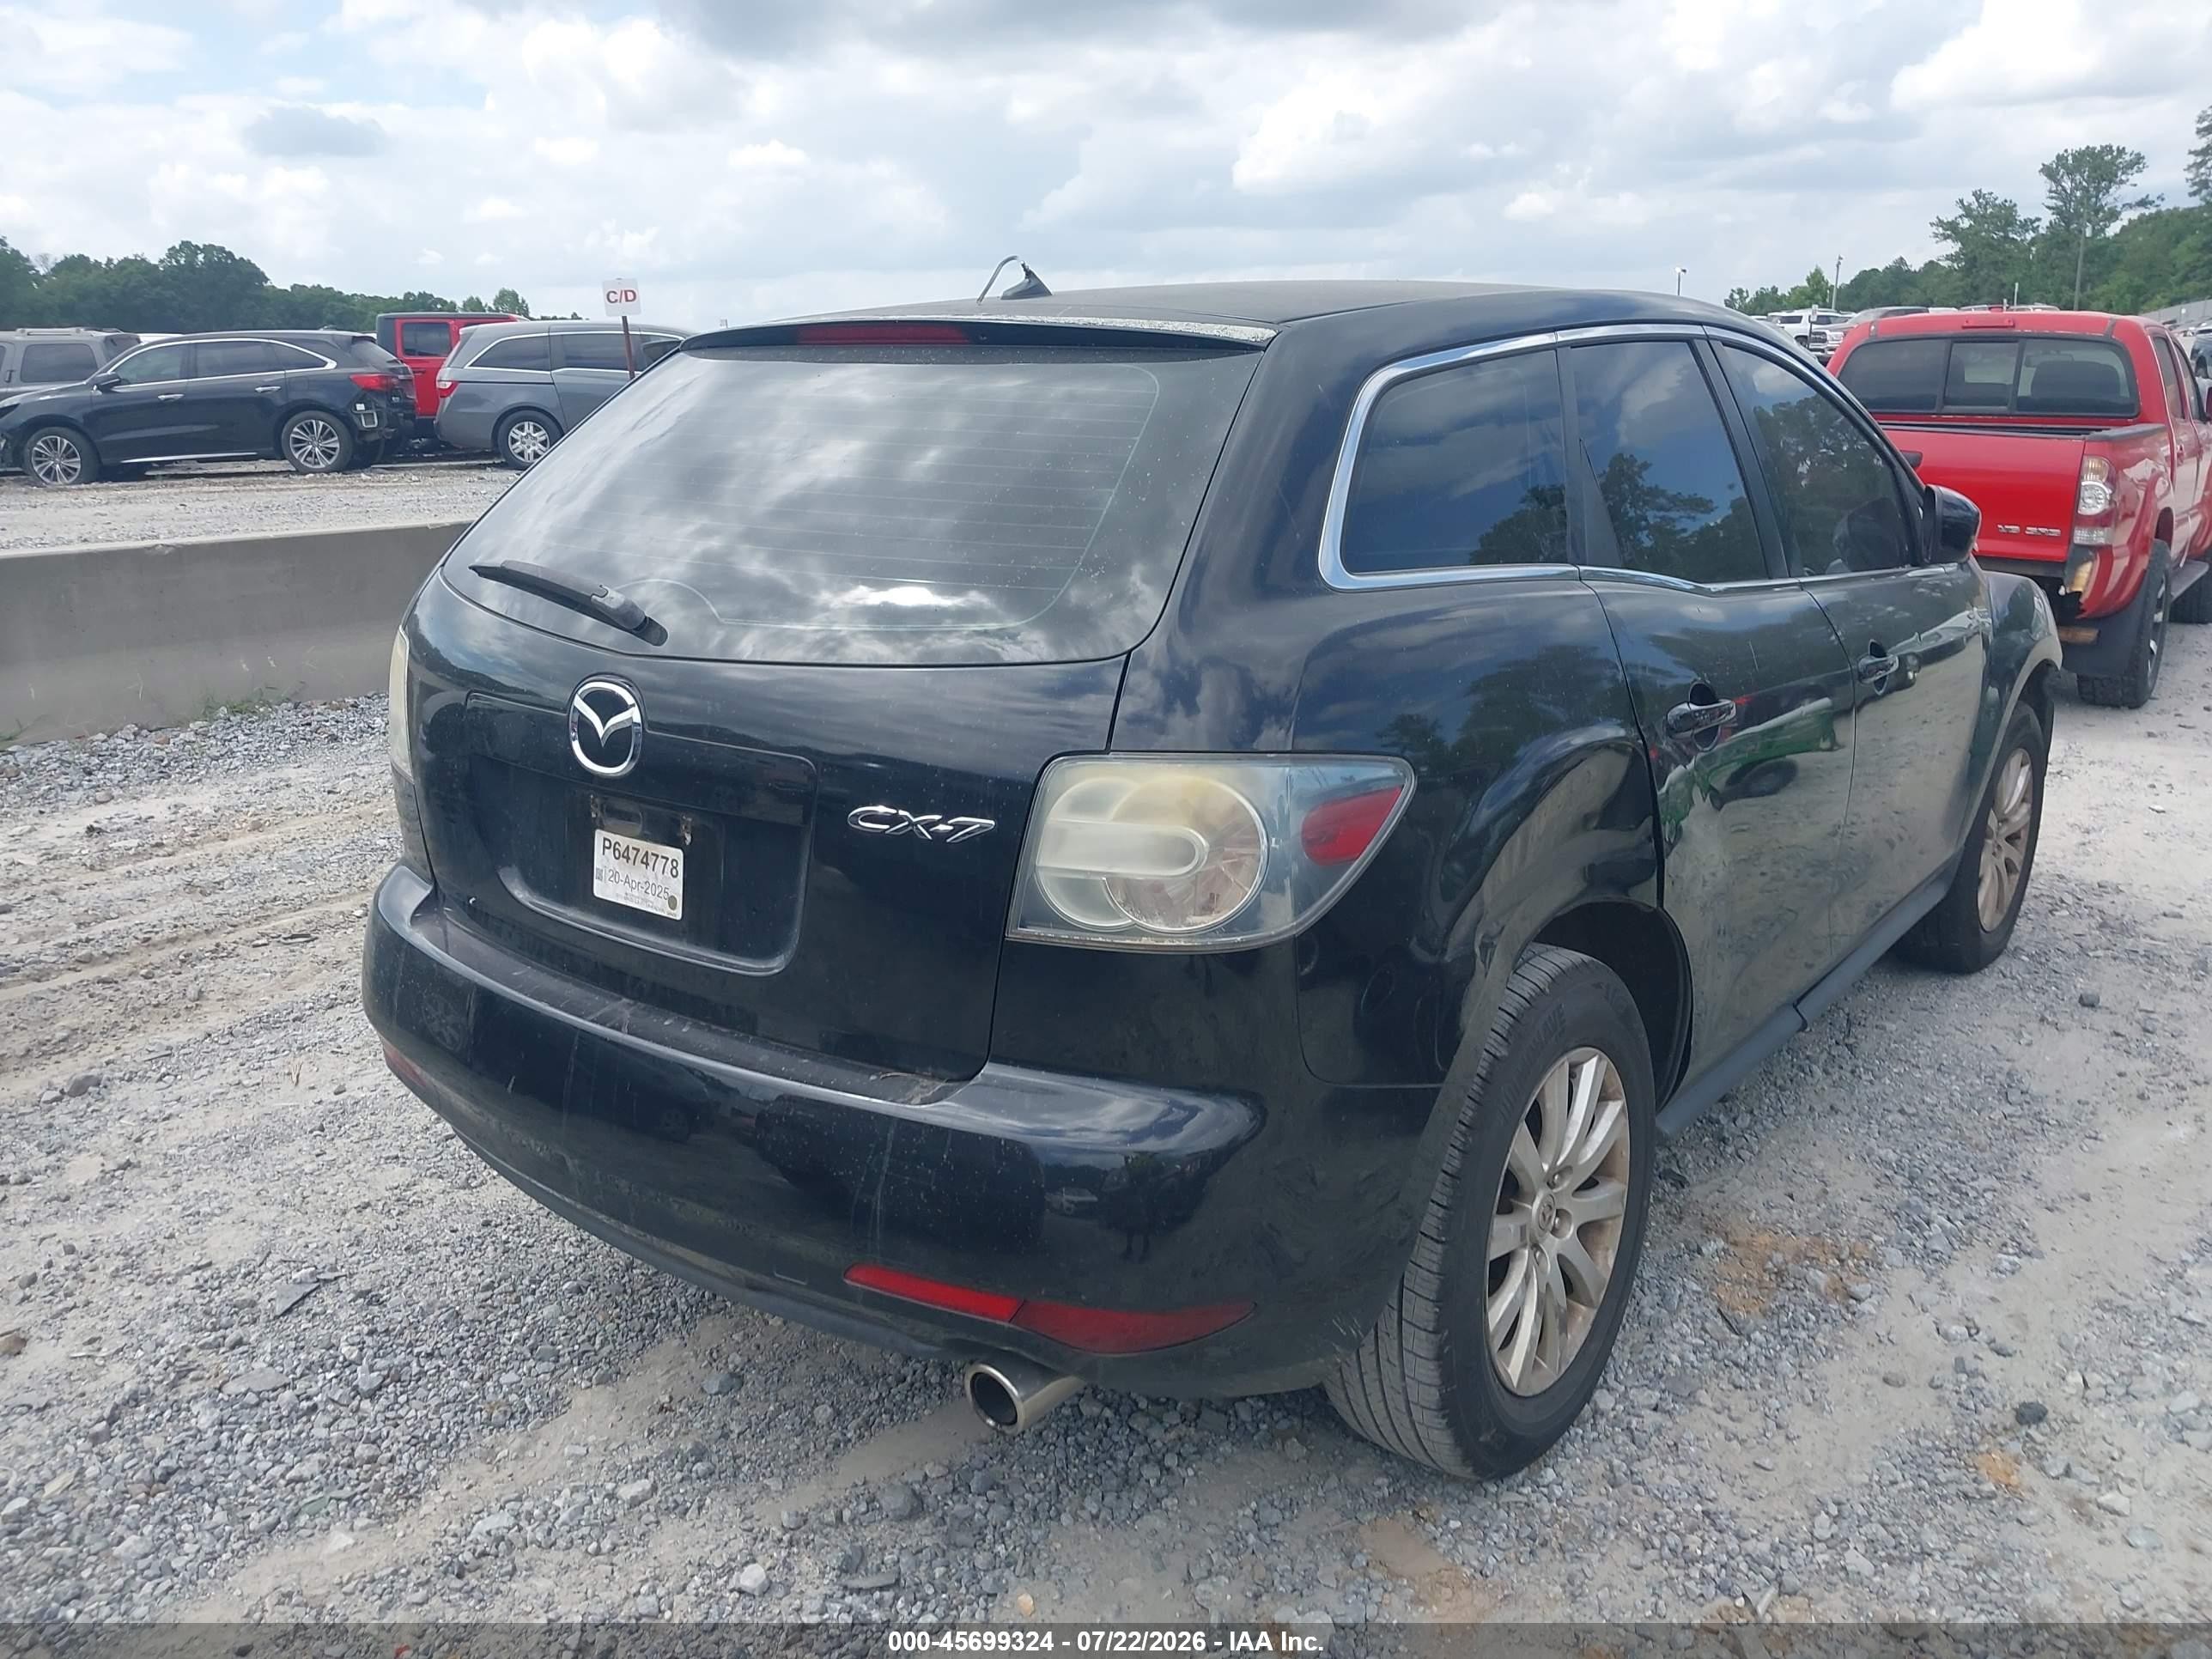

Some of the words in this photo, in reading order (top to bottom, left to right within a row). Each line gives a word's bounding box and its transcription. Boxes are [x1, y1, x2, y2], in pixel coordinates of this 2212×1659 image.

[606, 289, 636, 303] C/D
[848, 805, 996, 843] CX-7
[602, 836, 679, 878] P6474778
[608, 868, 670, 900] 20-Apr-2025
